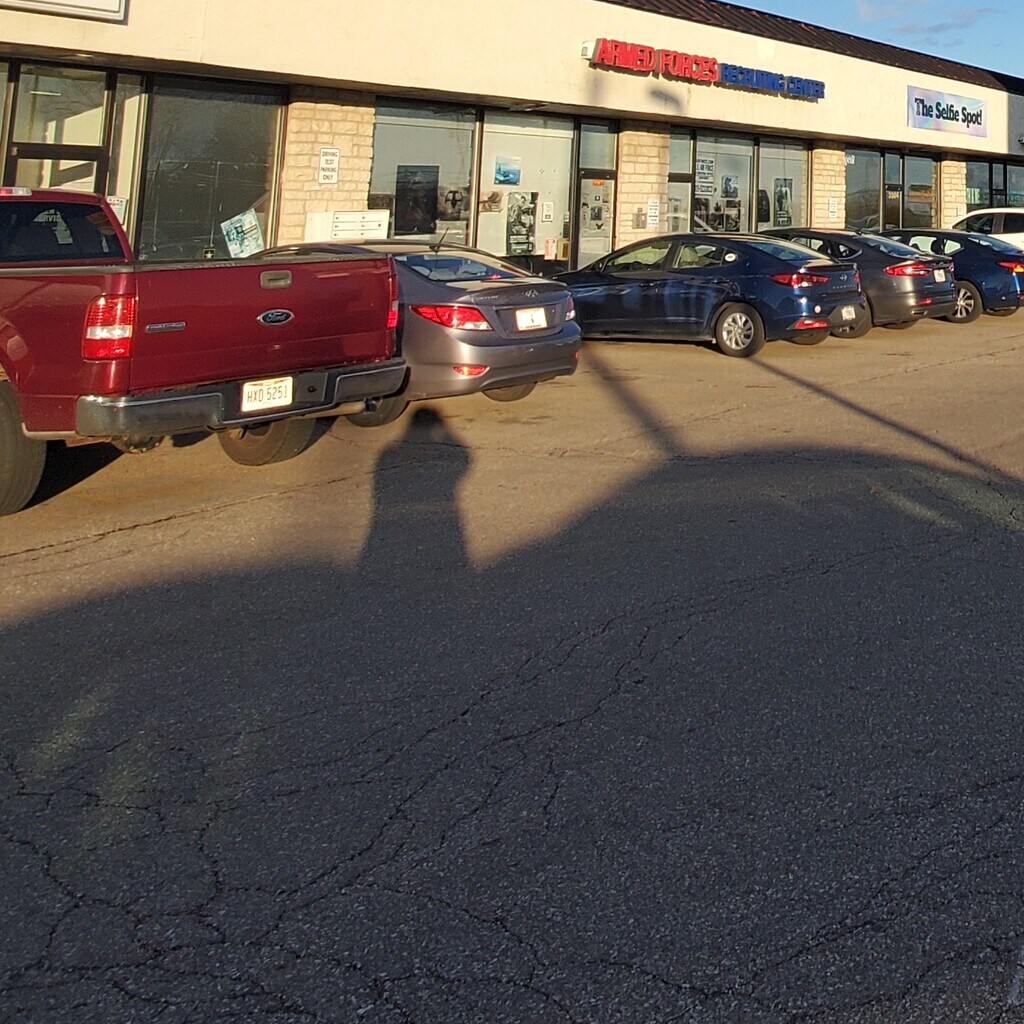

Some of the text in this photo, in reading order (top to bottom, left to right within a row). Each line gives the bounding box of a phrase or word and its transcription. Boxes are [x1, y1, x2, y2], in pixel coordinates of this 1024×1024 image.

[595, 38, 657, 72] ARMED
[658, 49, 719, 83] FORCES
[914, 97, 934, 118] The
[935, 101, 960, 123] Selfie
[961, 106, 983, 129] Spot!
[266, 385, 288, 401] 5251
